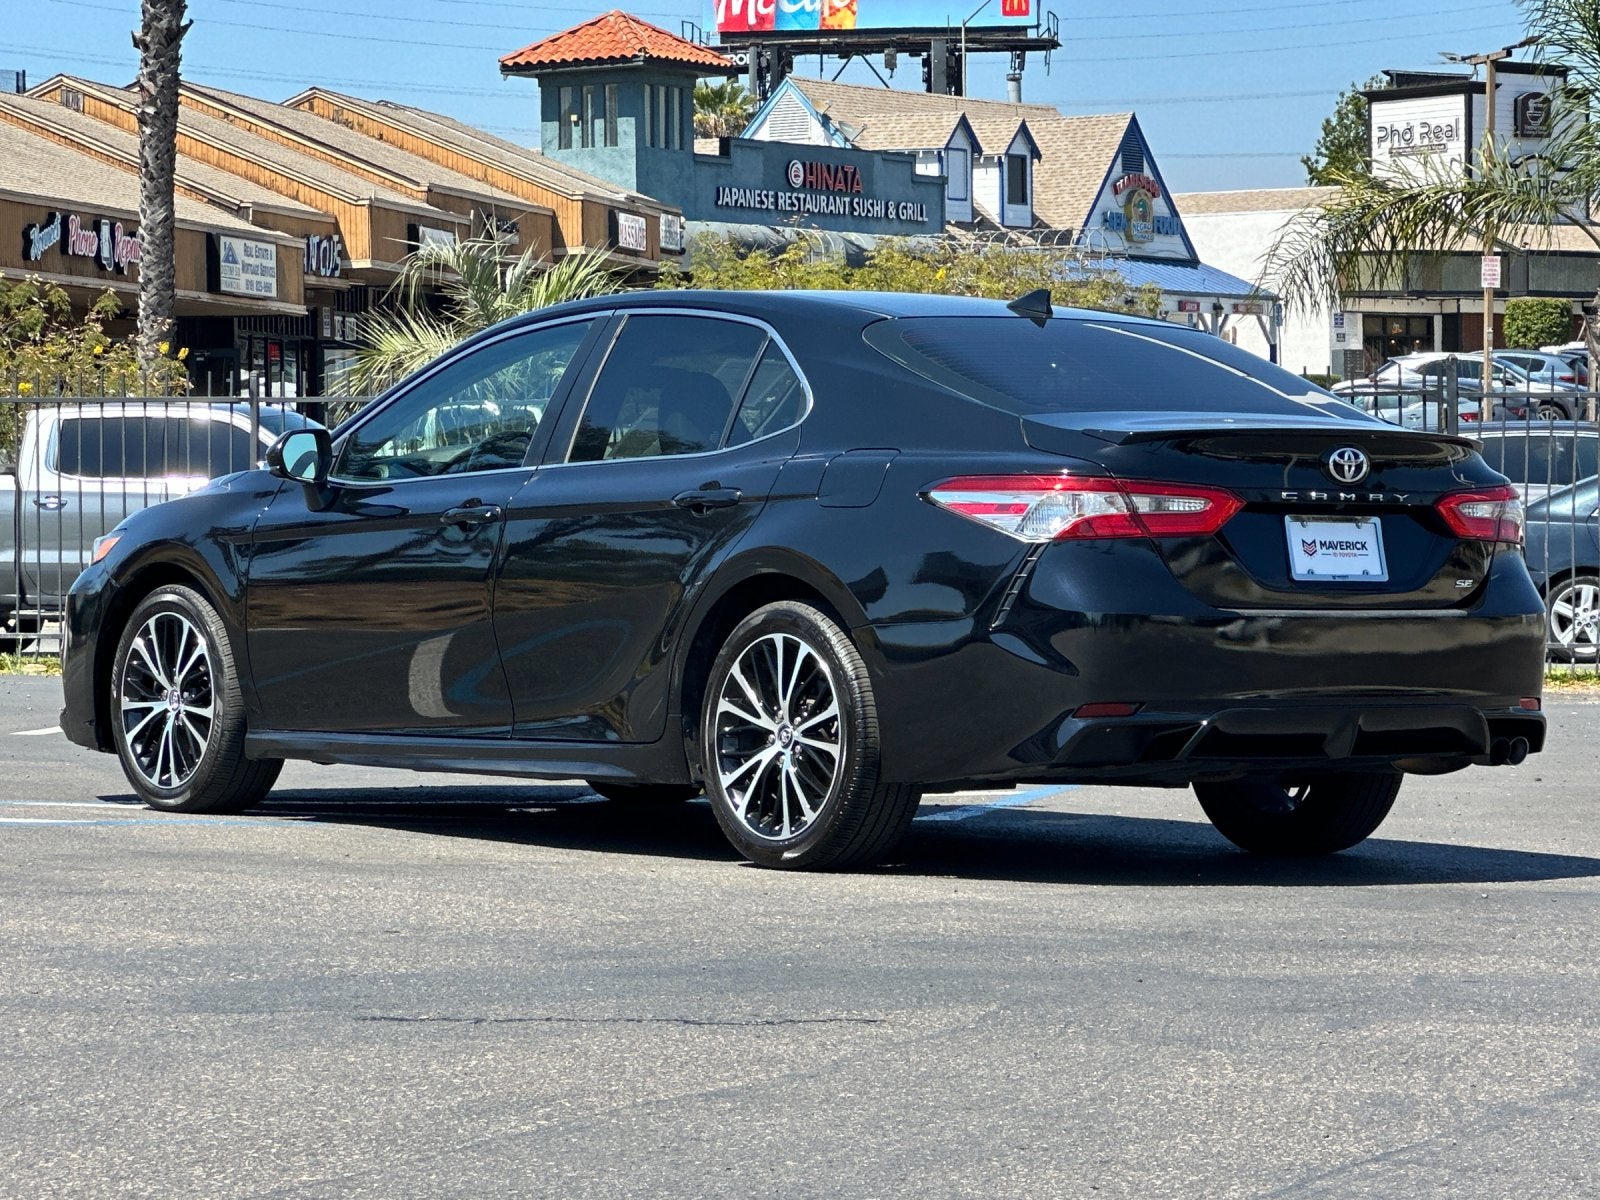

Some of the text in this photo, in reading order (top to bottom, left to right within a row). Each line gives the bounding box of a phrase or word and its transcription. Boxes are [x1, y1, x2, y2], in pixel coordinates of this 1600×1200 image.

[1419, 117, 1460, 144] Real
[806, 161, 864, 193] HINATA
[717, 186, 929, 222] JAPANESE RESTAURANT SUSHI & GRILL
[619, 222, 646, 250] MASSAGE
[1153, 215, 1181, 236] FOOD
[68, 214, 98, 257] Phone
[114, 221, 142, 276] Repai
[1281, 491, 1409, 501] CAMRY
[1320, 540, 1368, 551] MAVERICK
[1455, 579, 1473, 588] SE
